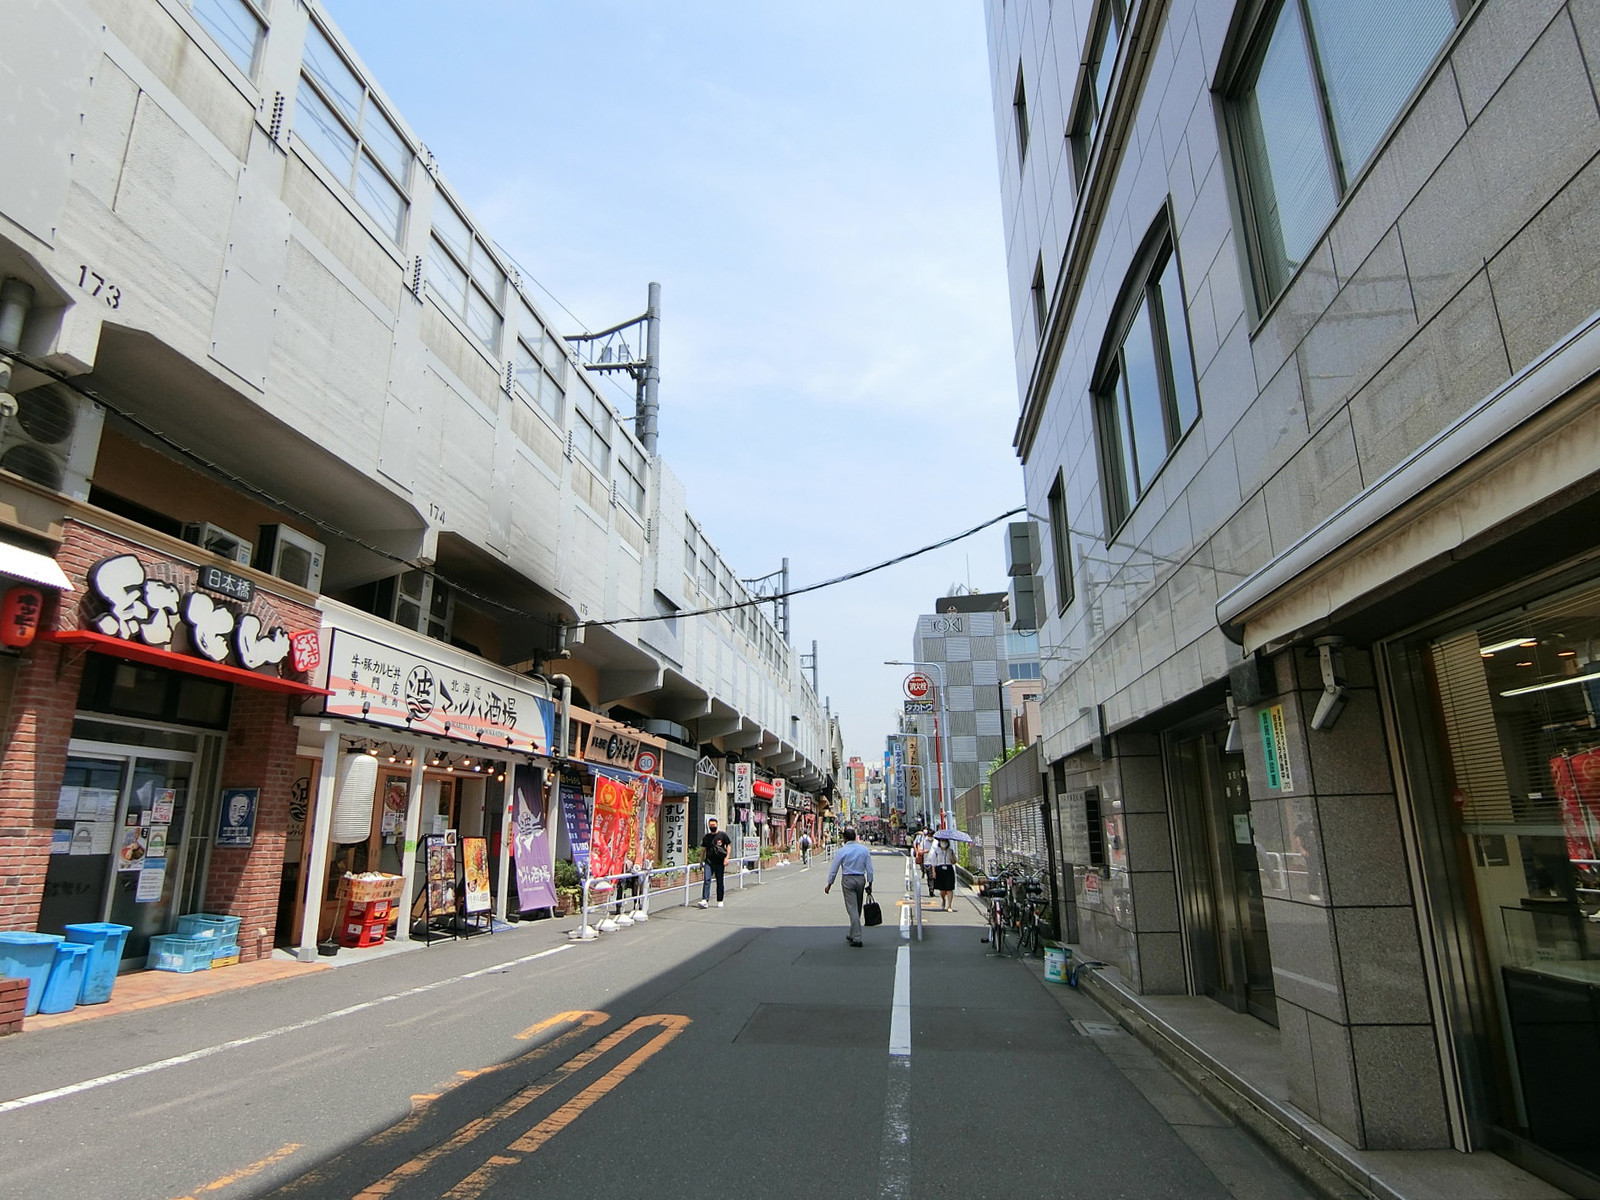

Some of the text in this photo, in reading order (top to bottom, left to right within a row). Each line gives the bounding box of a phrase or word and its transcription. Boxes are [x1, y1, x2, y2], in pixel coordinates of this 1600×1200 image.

[79, 265, 121, 309] 173
[430, 503, 445, 524] 174
[208, 569, 251, 600] 日本橋
[580, 603, 588, 615] 175
[929, 618, 962, 633] TOKI
[350, 670, 400, 696] 専門店
[909, 682, 927, 691] 消火栓
[640, 758, 653, 768] 30
[665, 804, 684, 815] すし
